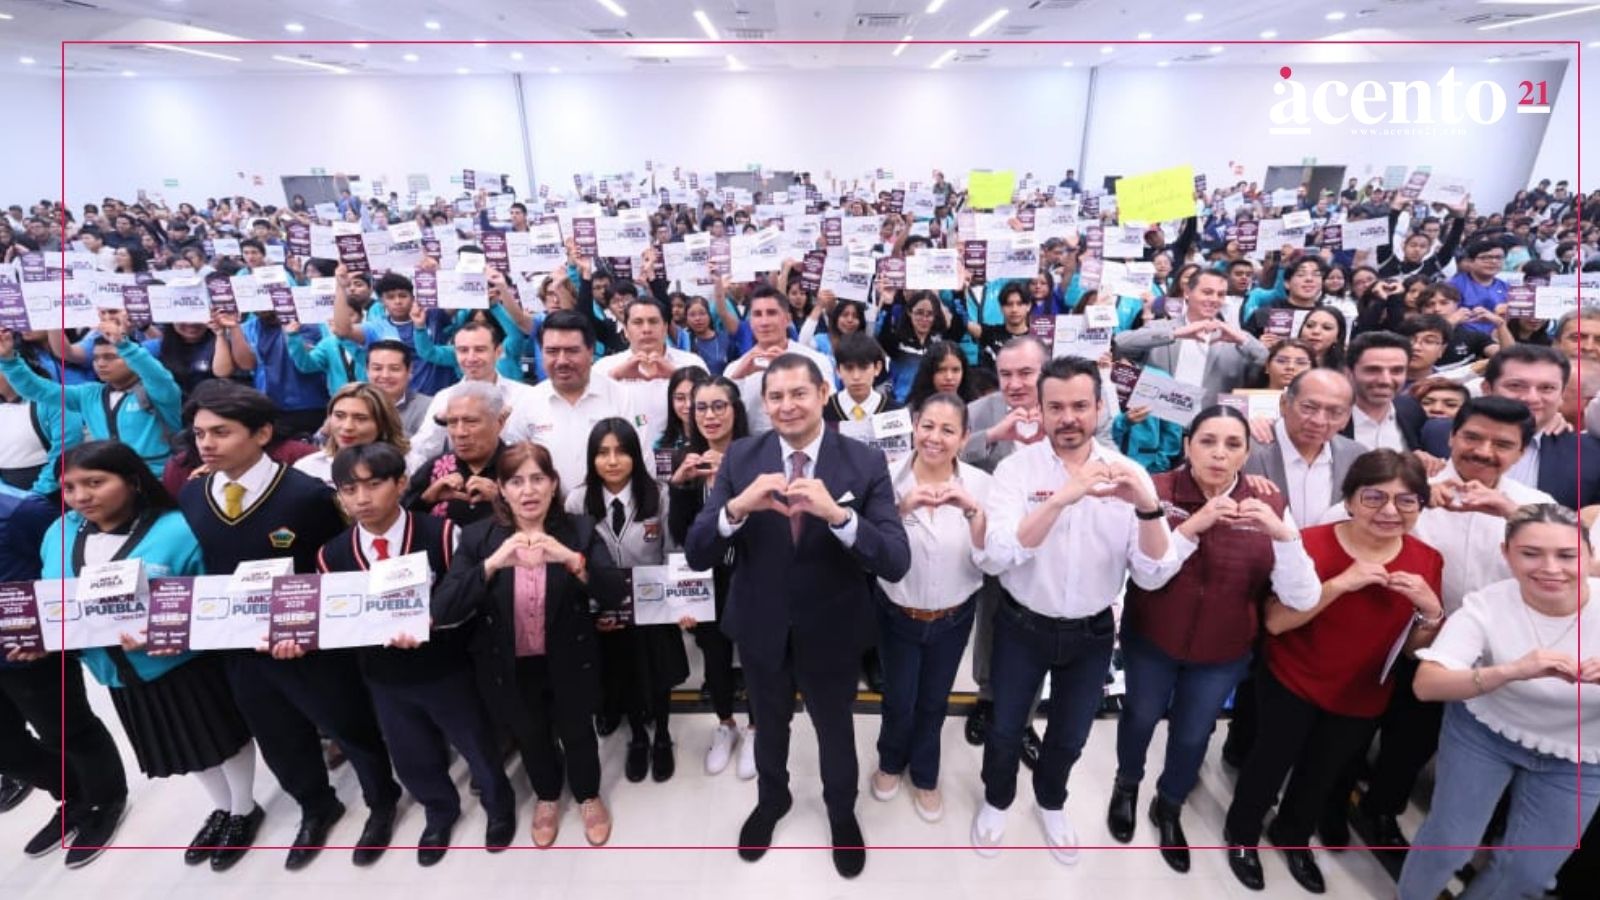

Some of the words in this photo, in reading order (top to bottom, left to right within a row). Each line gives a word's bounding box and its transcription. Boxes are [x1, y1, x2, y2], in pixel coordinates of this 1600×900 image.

[665, 587, 709, 598] PUEBLA
[85, 602, 147, 616] PUEBLA
[232, 602, 271, 616] PUEB
[365, 598, 424, 613] PUEBLA
